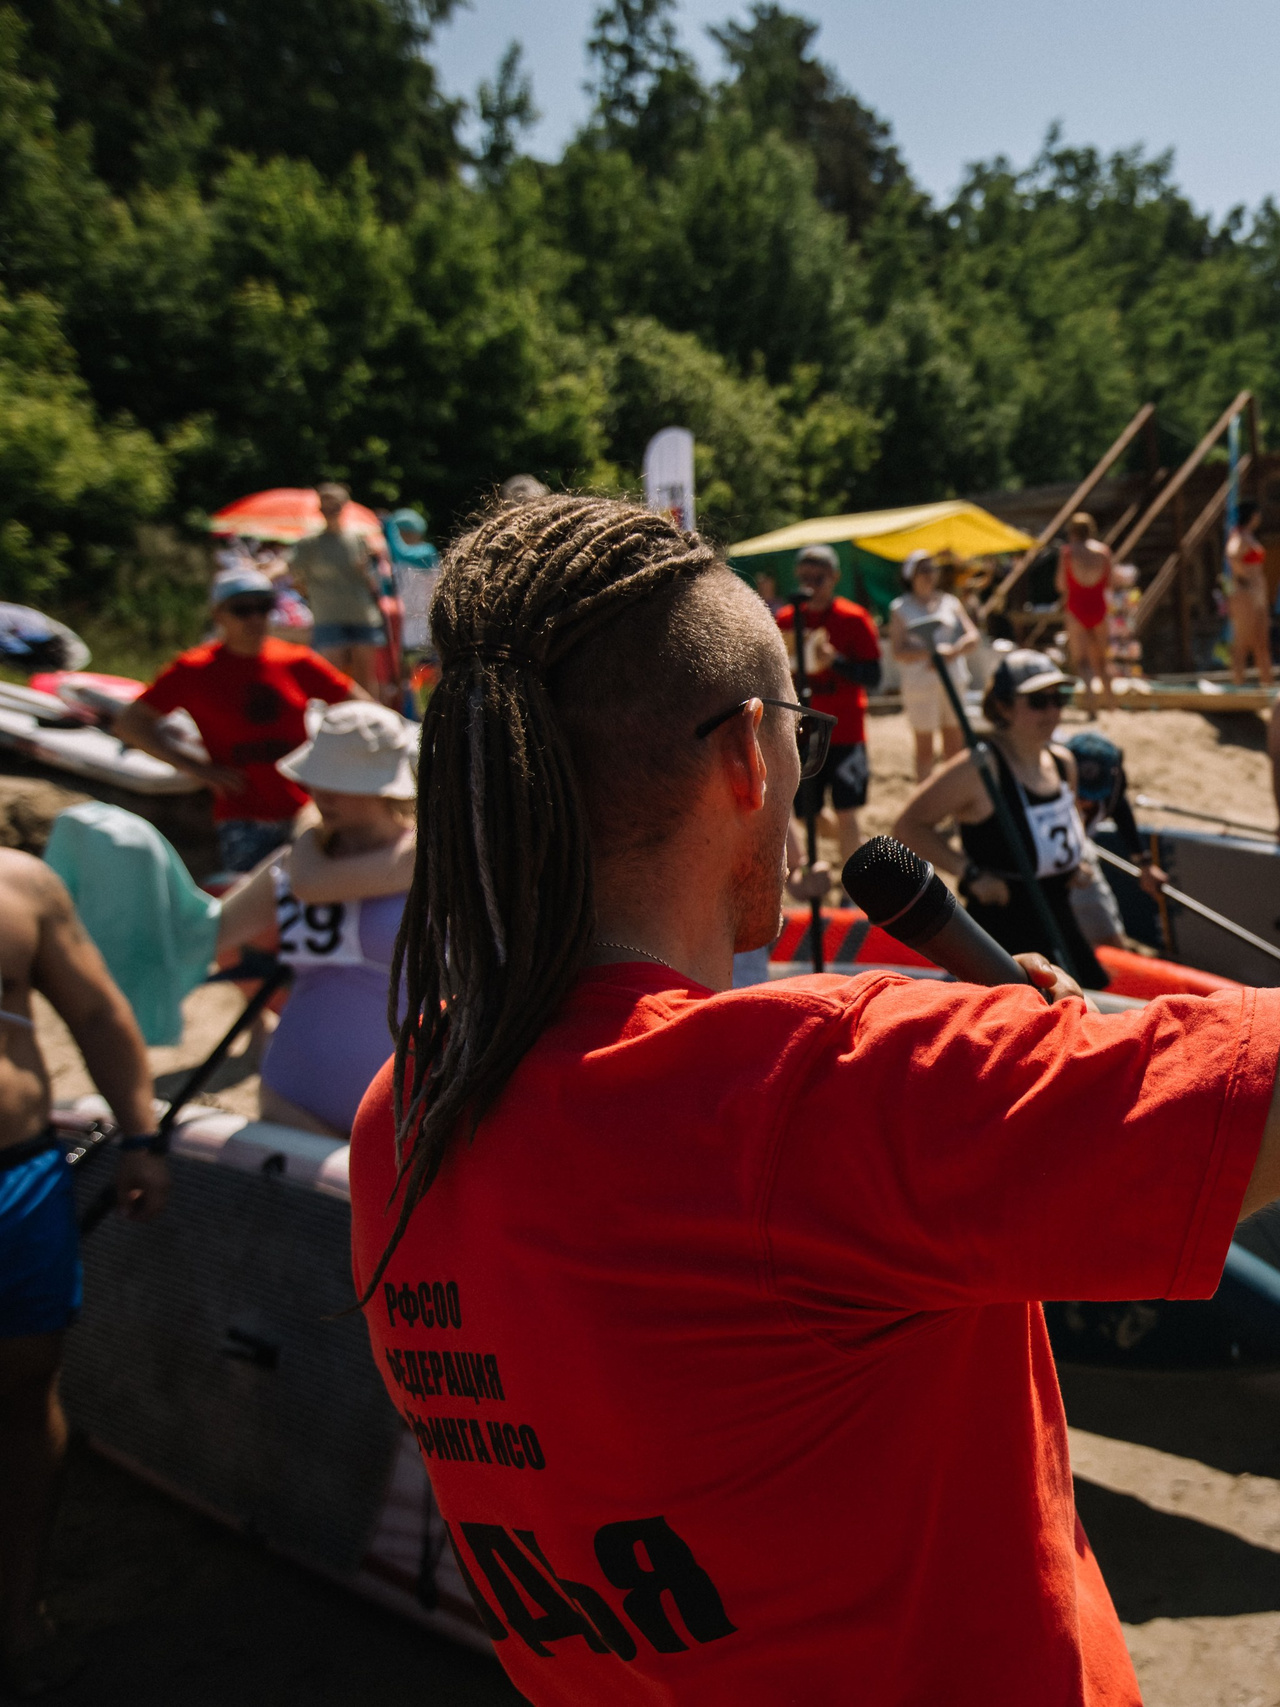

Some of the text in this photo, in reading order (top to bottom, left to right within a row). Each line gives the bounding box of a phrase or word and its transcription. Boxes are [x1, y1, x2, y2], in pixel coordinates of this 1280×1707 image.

[1050, 826, 1074, 868] 3
[278, 895, 346, 956] 29
[383, 1281, 462, 1329] РФСОО
